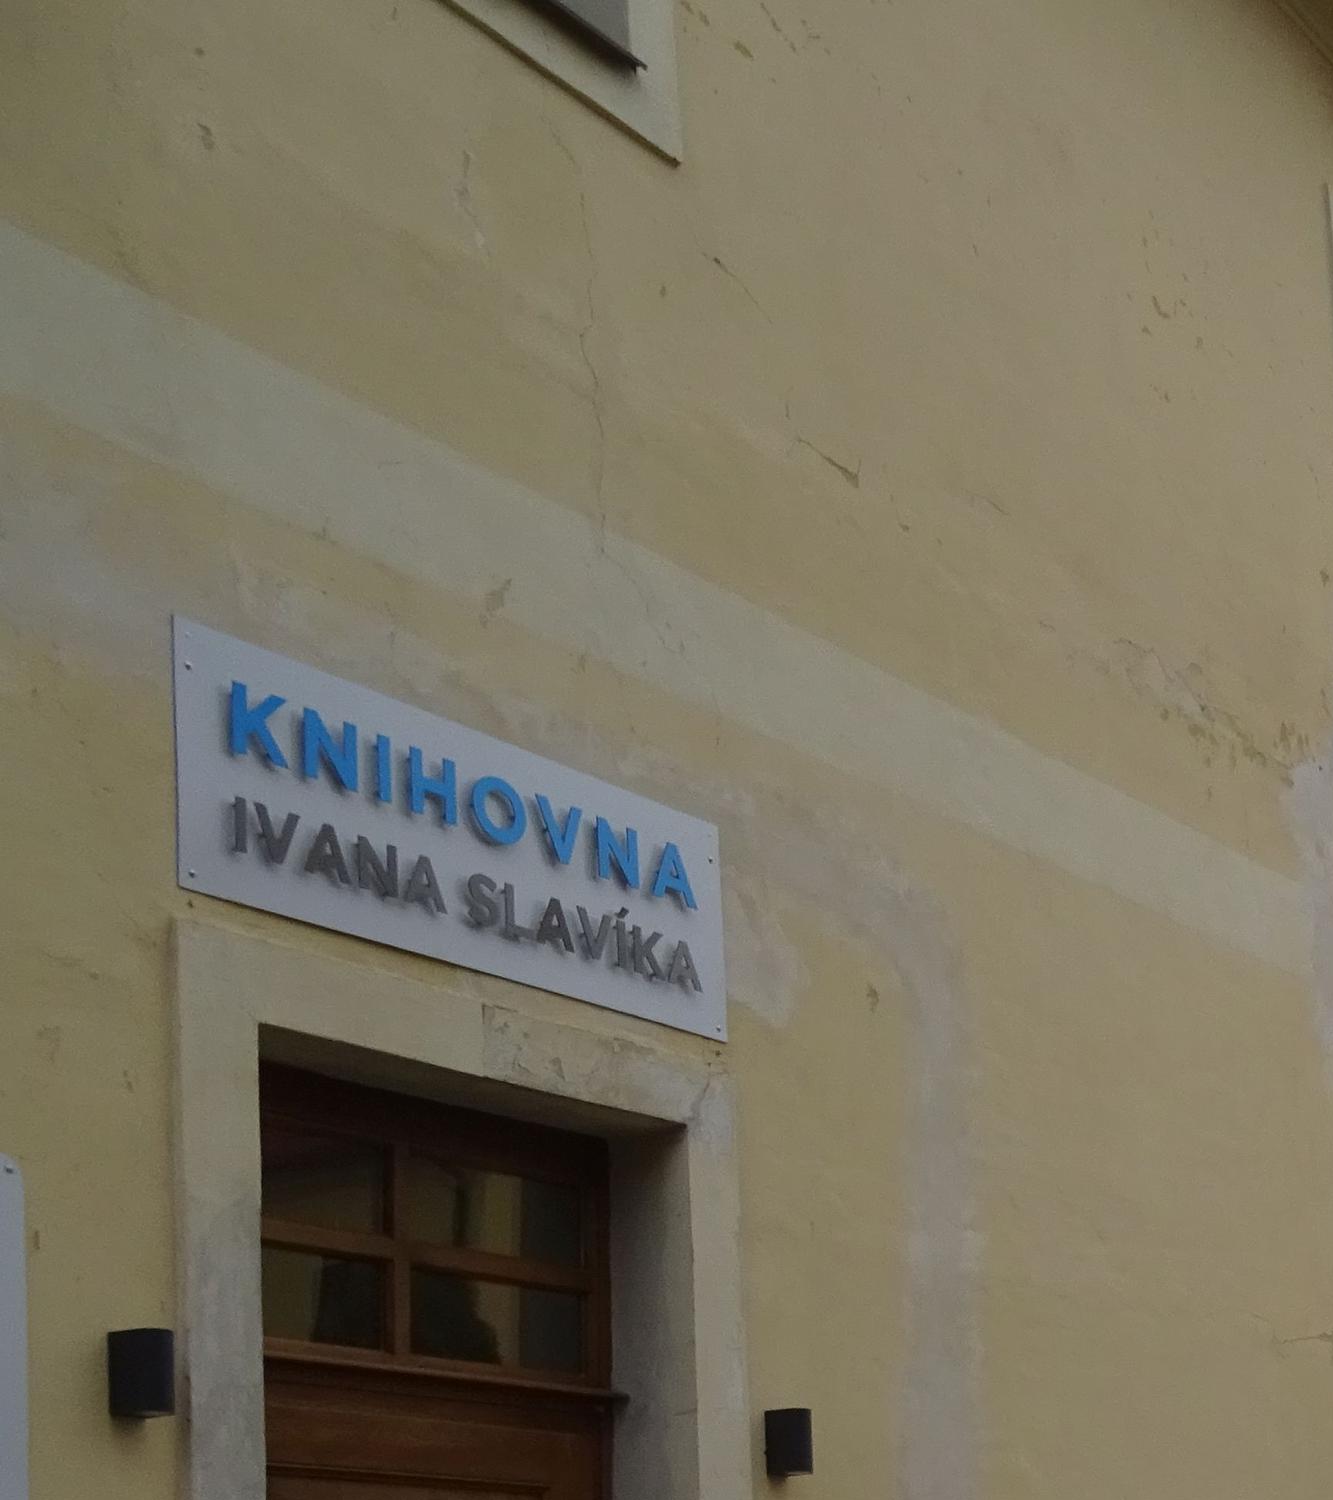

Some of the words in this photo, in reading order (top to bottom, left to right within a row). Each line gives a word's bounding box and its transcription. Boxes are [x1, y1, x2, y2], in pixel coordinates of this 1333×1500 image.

[230, 679, 698, 911] KNIHOVNA
[231, 795, 449, 915] IVANA
[464, 872, 704, 993] SLAVÍKA
